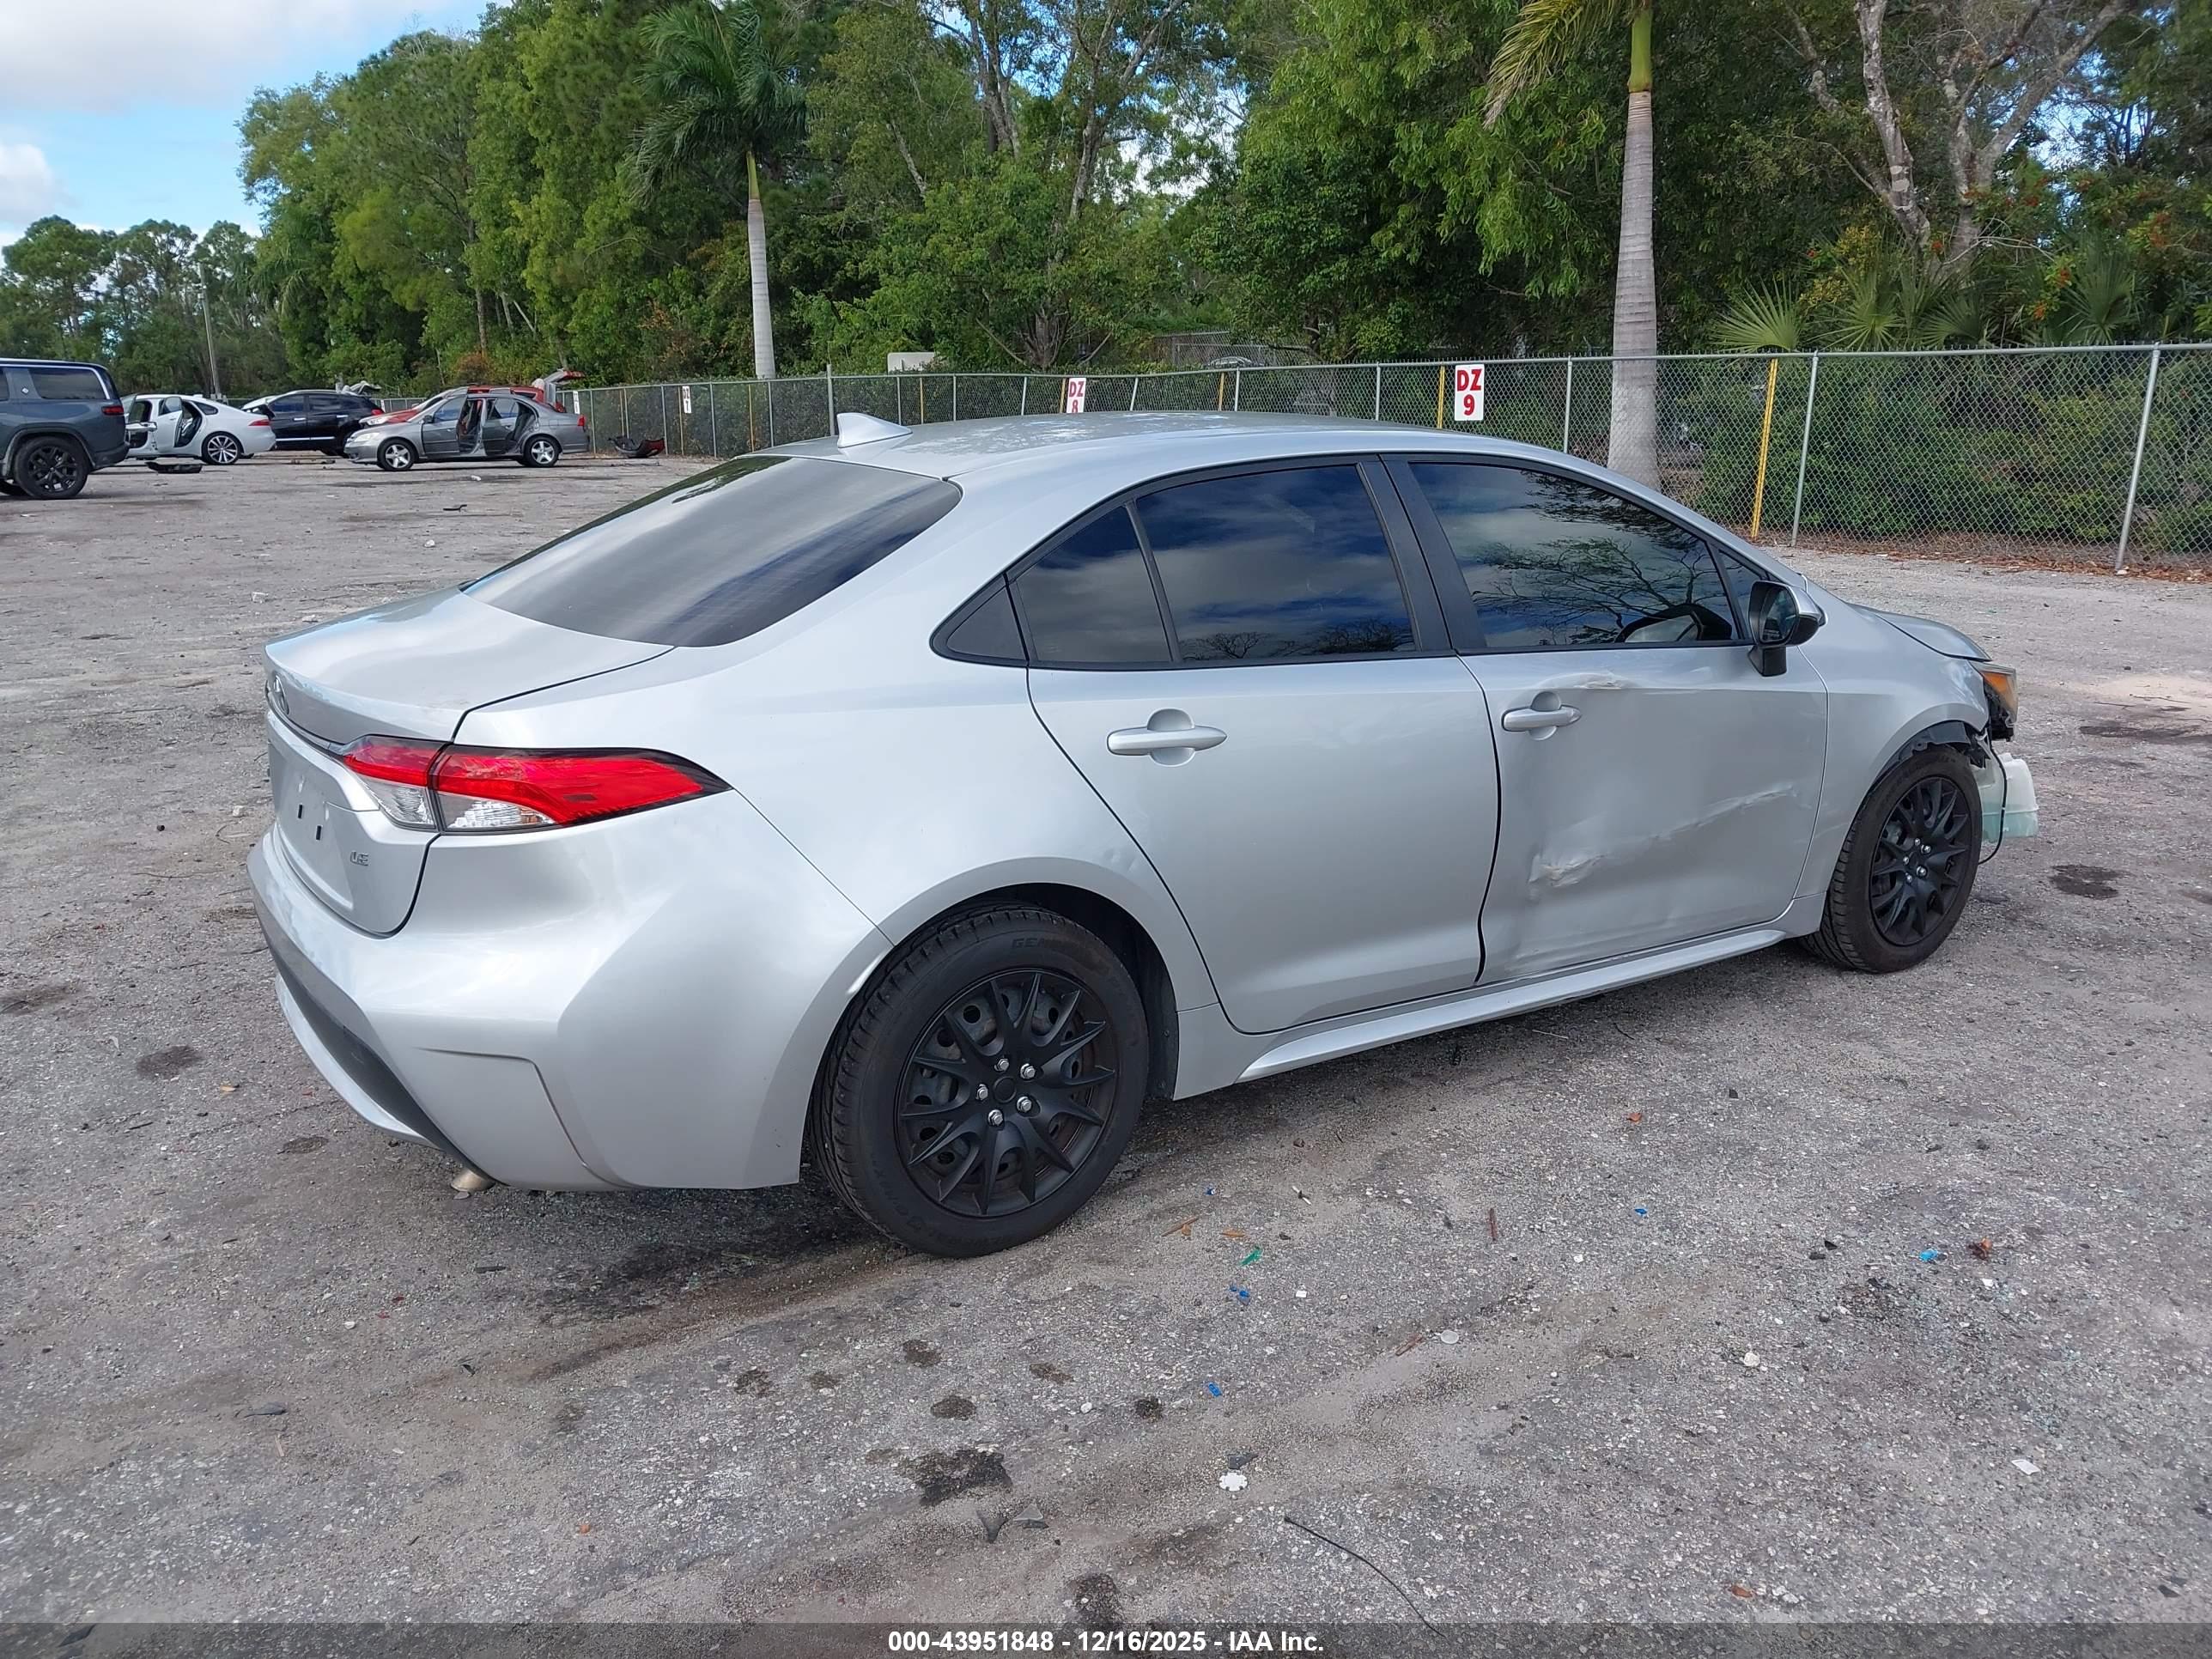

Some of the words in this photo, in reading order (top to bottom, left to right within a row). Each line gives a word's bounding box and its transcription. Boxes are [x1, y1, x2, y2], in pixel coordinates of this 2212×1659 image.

[1069, 380, 1085, 398] DZ
[1456, 368, 1483, 392] DZ
[1072, 399, 1079, 413] 8
[1463, 393, 1475, 416] 9
[350, 850, 369, 866] LE
